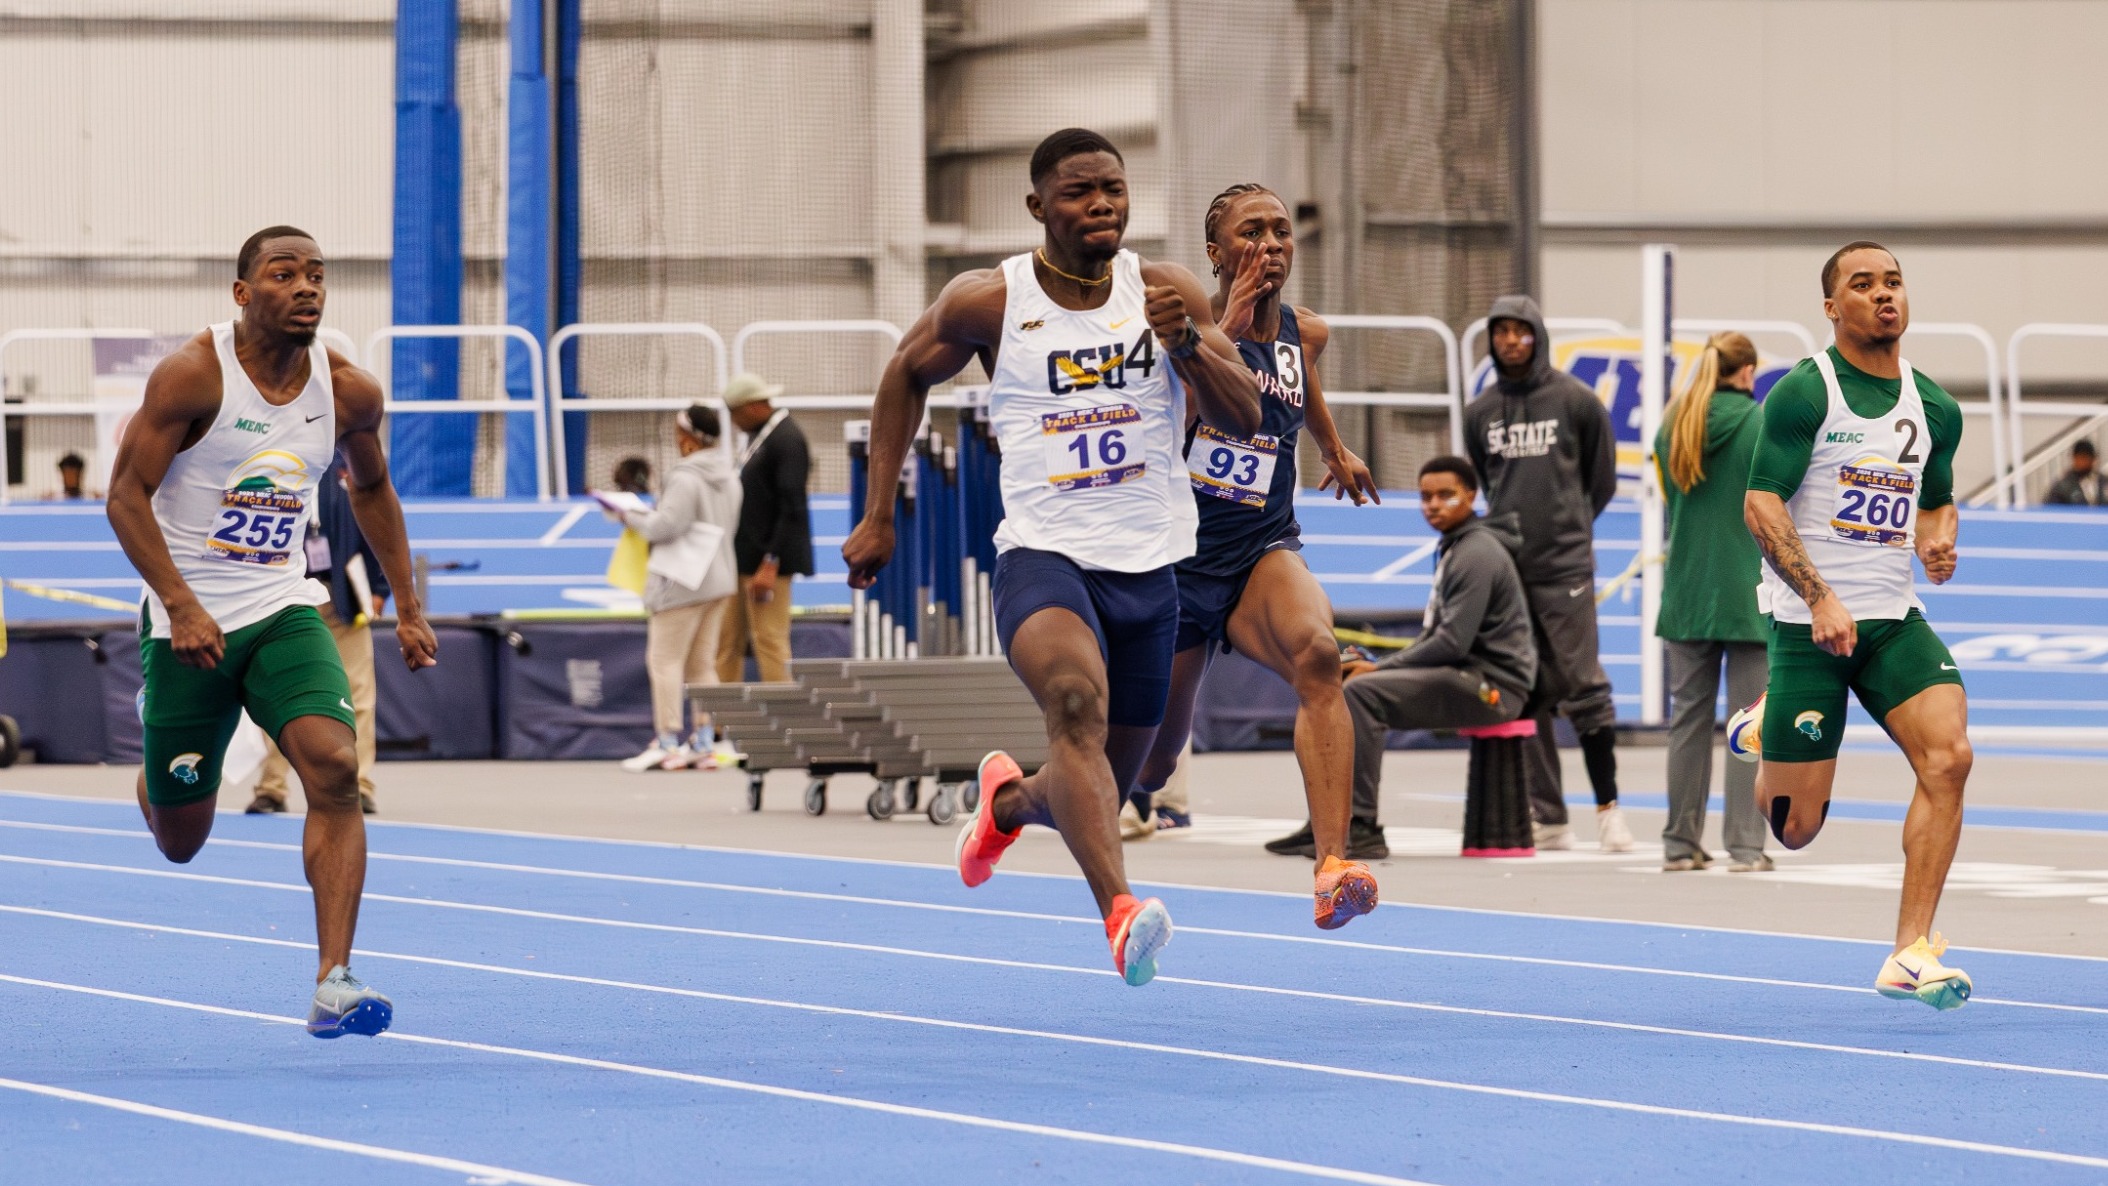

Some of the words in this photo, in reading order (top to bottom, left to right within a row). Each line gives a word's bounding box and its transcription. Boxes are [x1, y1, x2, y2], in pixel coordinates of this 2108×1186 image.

[1047, 342, 1127, 395] CSU
[1125, 329, 1156, 378] 4
[1277, 345, 1299, 390] 3
[234, 418, 271, 435] MEAC
[1046, 415, 1086, 428] TRACK
[1103, 408, 1136, 420] FIELD
[1508, 419, 1559, 448] STATE
[1825, 432, 1865, 443] MEAC
[1068, 429, 1127, 469] 16
[1250, 438, 1277, 450] FIELD
[1894, 418, 1920, 464] 2
[1206, 447, 1260, 486] 93
[1844, 472, 1879, 484] TRACK
[1890, 479, 1915, 489] FIELD
[226, 493, 263, 505] TRACK
[275, 499, 303, 509] FIELD
[1836, 489, 1910, 529] 260
[213, 509, 296, 549] 255
